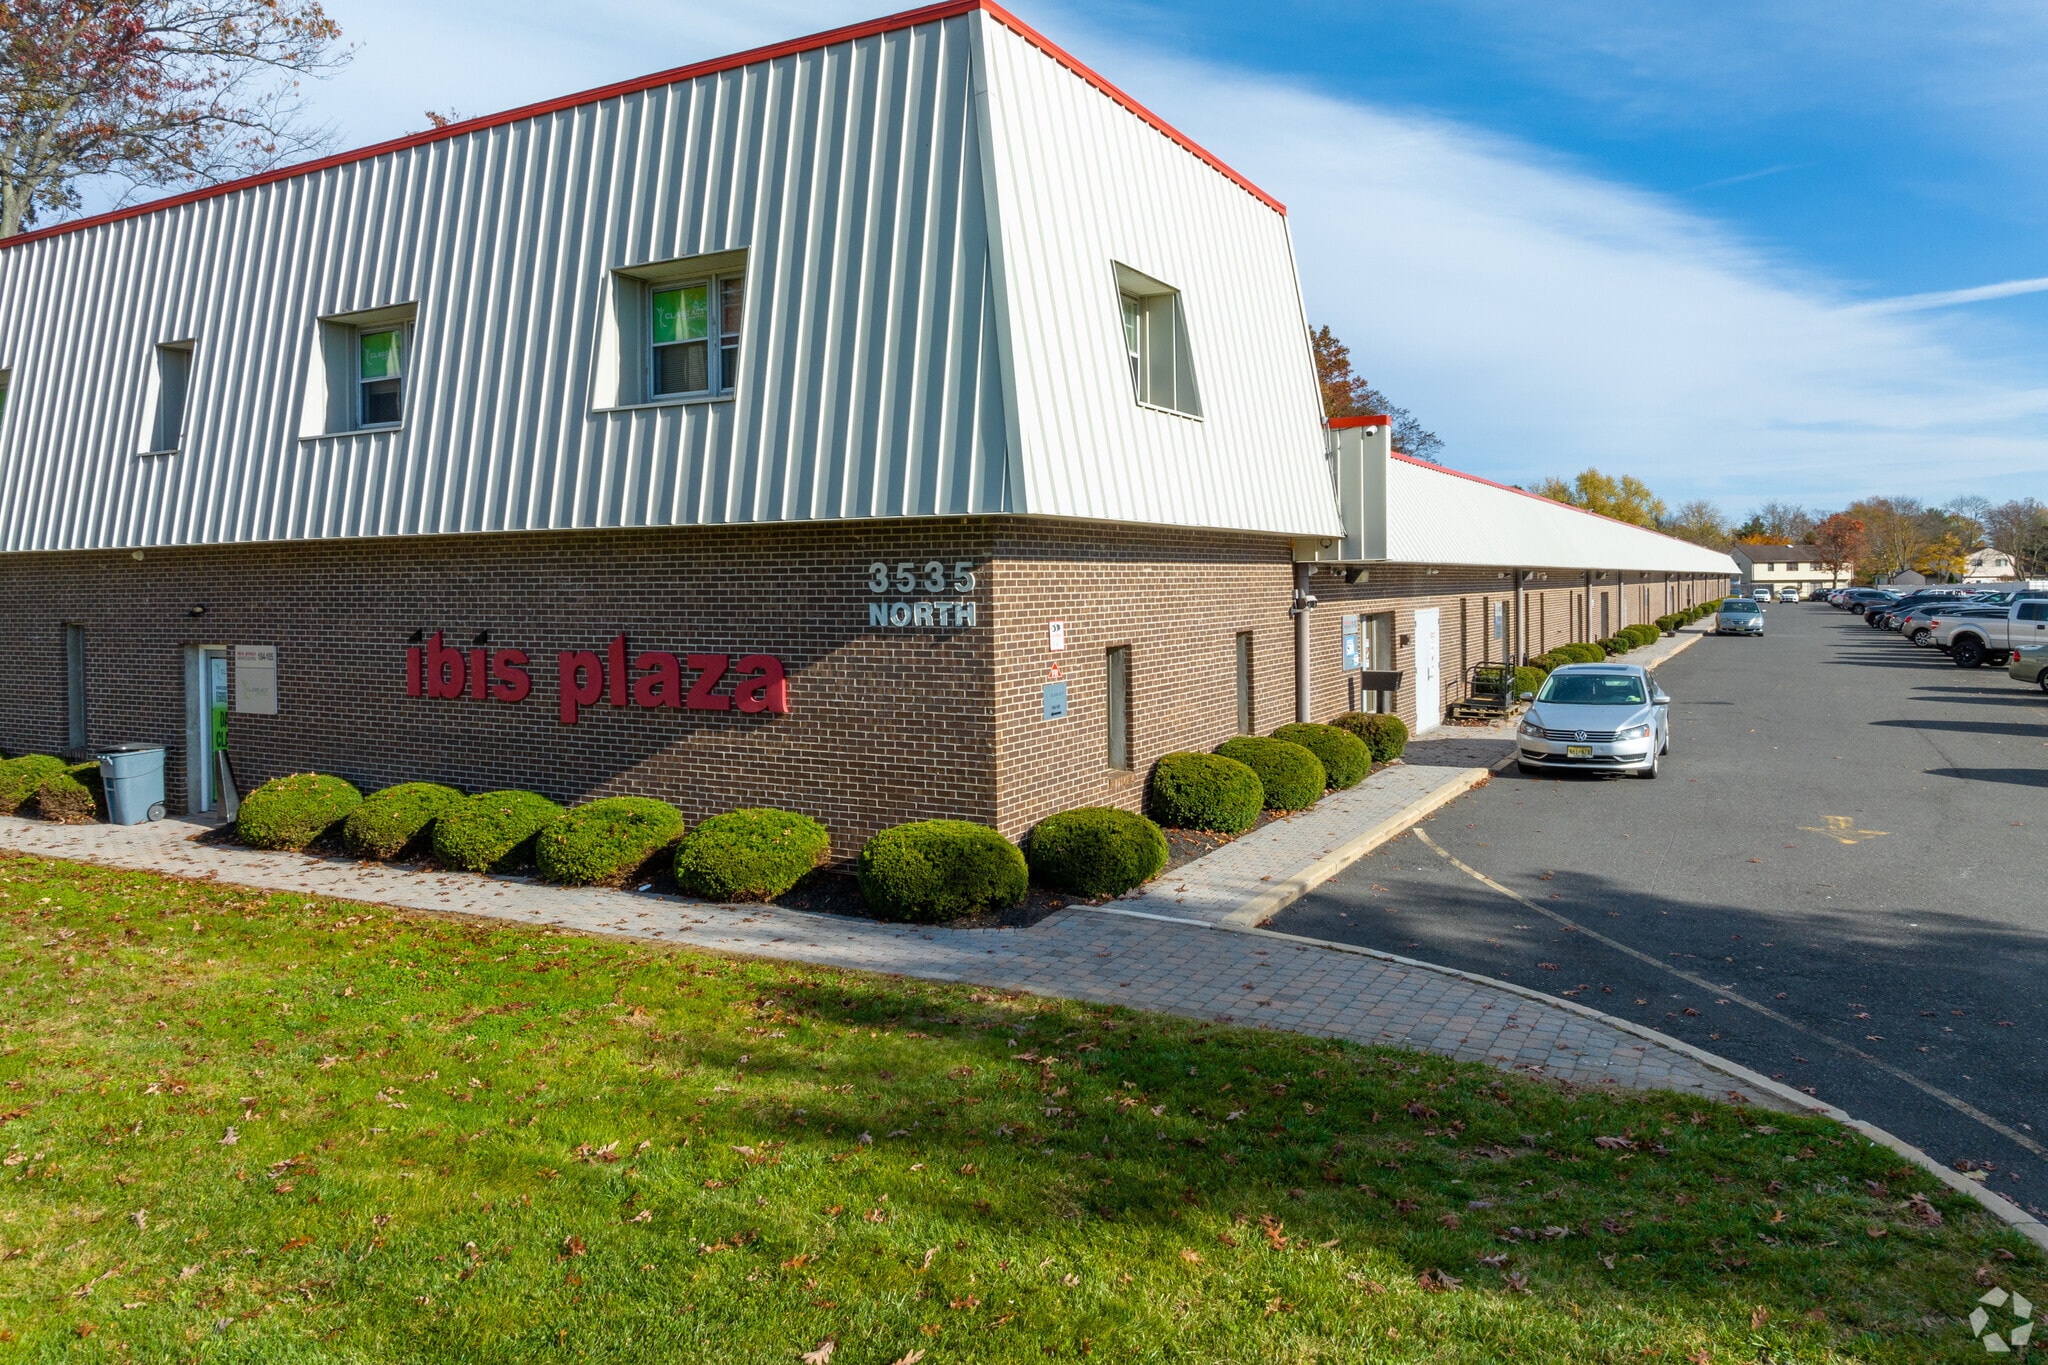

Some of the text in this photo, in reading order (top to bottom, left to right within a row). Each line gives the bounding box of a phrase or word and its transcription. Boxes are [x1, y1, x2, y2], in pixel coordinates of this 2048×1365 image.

[868, 561, 976, 593] 3535
[868, 601, 976, 627] NORTH
[406, 627, 789, 724] ibis plaza
